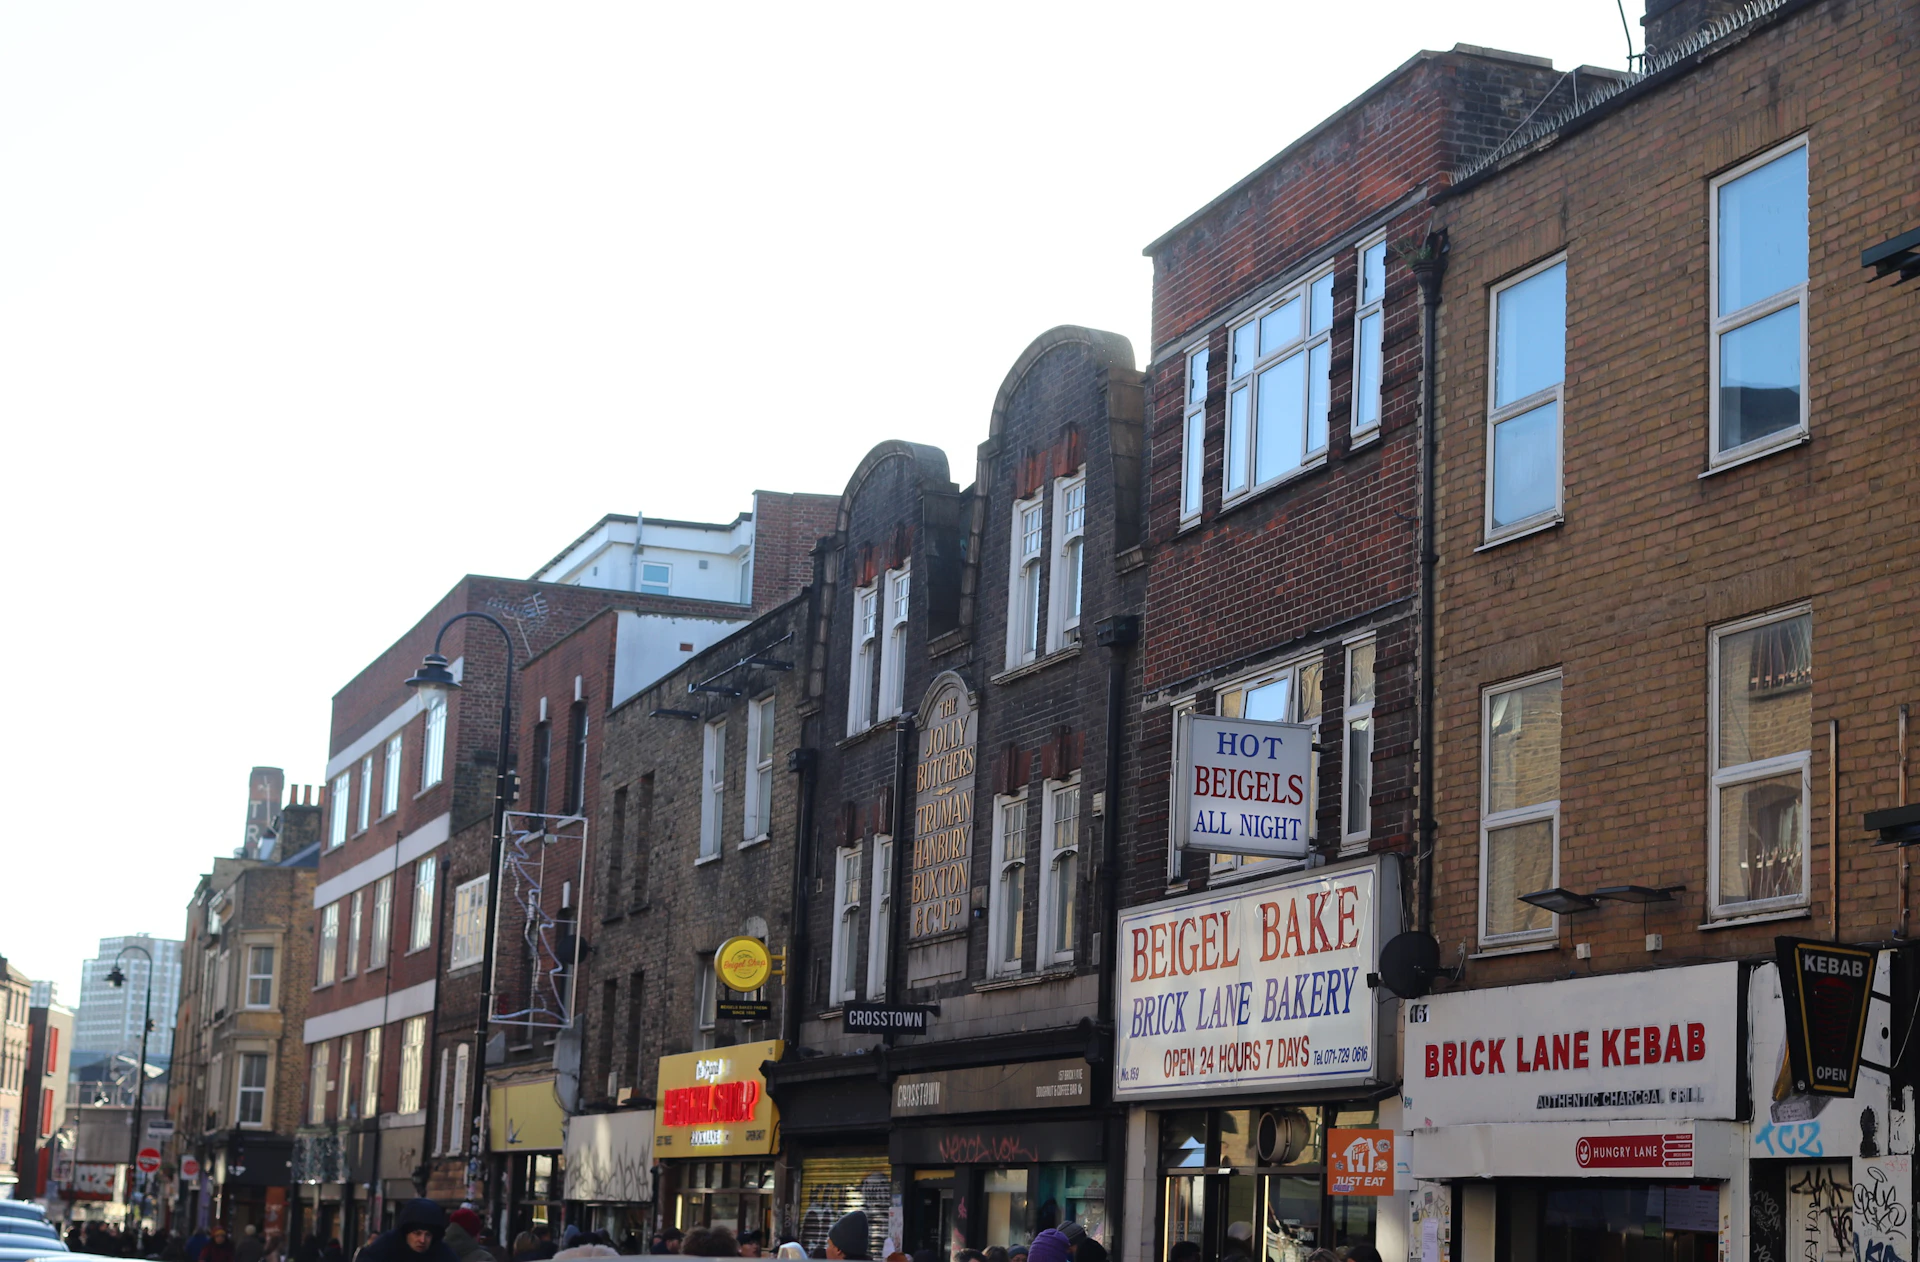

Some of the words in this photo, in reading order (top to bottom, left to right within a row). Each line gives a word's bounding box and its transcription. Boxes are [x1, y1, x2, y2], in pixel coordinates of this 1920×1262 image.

[939, 697, 958, 719] THE
[925, 715, 970, 759] JOLLY
[1216, 731, 1283, 760] HOT
[916, 744, 974, 793] BUTCHERS
[1194, 765, 1303, 806] BEIGELS
[916, 790, 973, 836] TRUMAN
[1193, 809, 1232, 835] ALL
[1239, 813, 1301, 841] NIGHT
[914, 824, 971, 870] HANBURY
[912, 861, 969, 904] BUXTON
[914, 908, 923, 938] &
[1131, 909, 1240, 983] BEIGEL
[1259, 886, 1360, 963] BAKE
[724, 959, 746, 972] Beigel
[1804, 954, 1864, 978] KEBAB
[1130, 991, 1189, 1039] BRICK
[1196, 982, 1253, 1030] LANE
[1261, 967, 1359, 1023] BAKERY
[1410, 1004, 1430, 1024] 161
[848, 1010, 923, 1028] CROSSTOWN
[1164, 1046, 1195, 1078] OPEN
[1199, 1045, 1215, 1075] 24
[1219, 1040, 1261, 1073] HOURS
[1265, 1039, 1274, 1070] 7
[1278, 1035, 1310, 1068] DAYS
[1324, 1047, 1350, 1065] 071-729
[1352, 1045, 1368, 1062] 0616
[1425, 1038, 1506, 1078] BRICK
[1516, 1031, 1590, 1073] LANE
[1601, 1022, 1706, 1068] KEBAB
[1130, 1067, 1139, 1080] 159
[1816, 1065, 1847, 1082] OPEN
[897, 1081, 940, 1108] CROSSTOWN
[1057, 1084, 1069, 1096] COFFEE
[1069, 1083, 1077, 1095] BAR
[1536, 1092, 1600, 1110] AUTHENTIC
[1602, 1088, 1665, 1107] CHARCOAL
[1668, 1087, 1704, 1103] GRILL
[1593, 1146, 1631, 1158] HUNGRY
[1634, 1145, 1657, 1158] LANE
[1336, 1176, 1363, 1186] JUST
[1364, 1176, 1386, 1186] EAT
